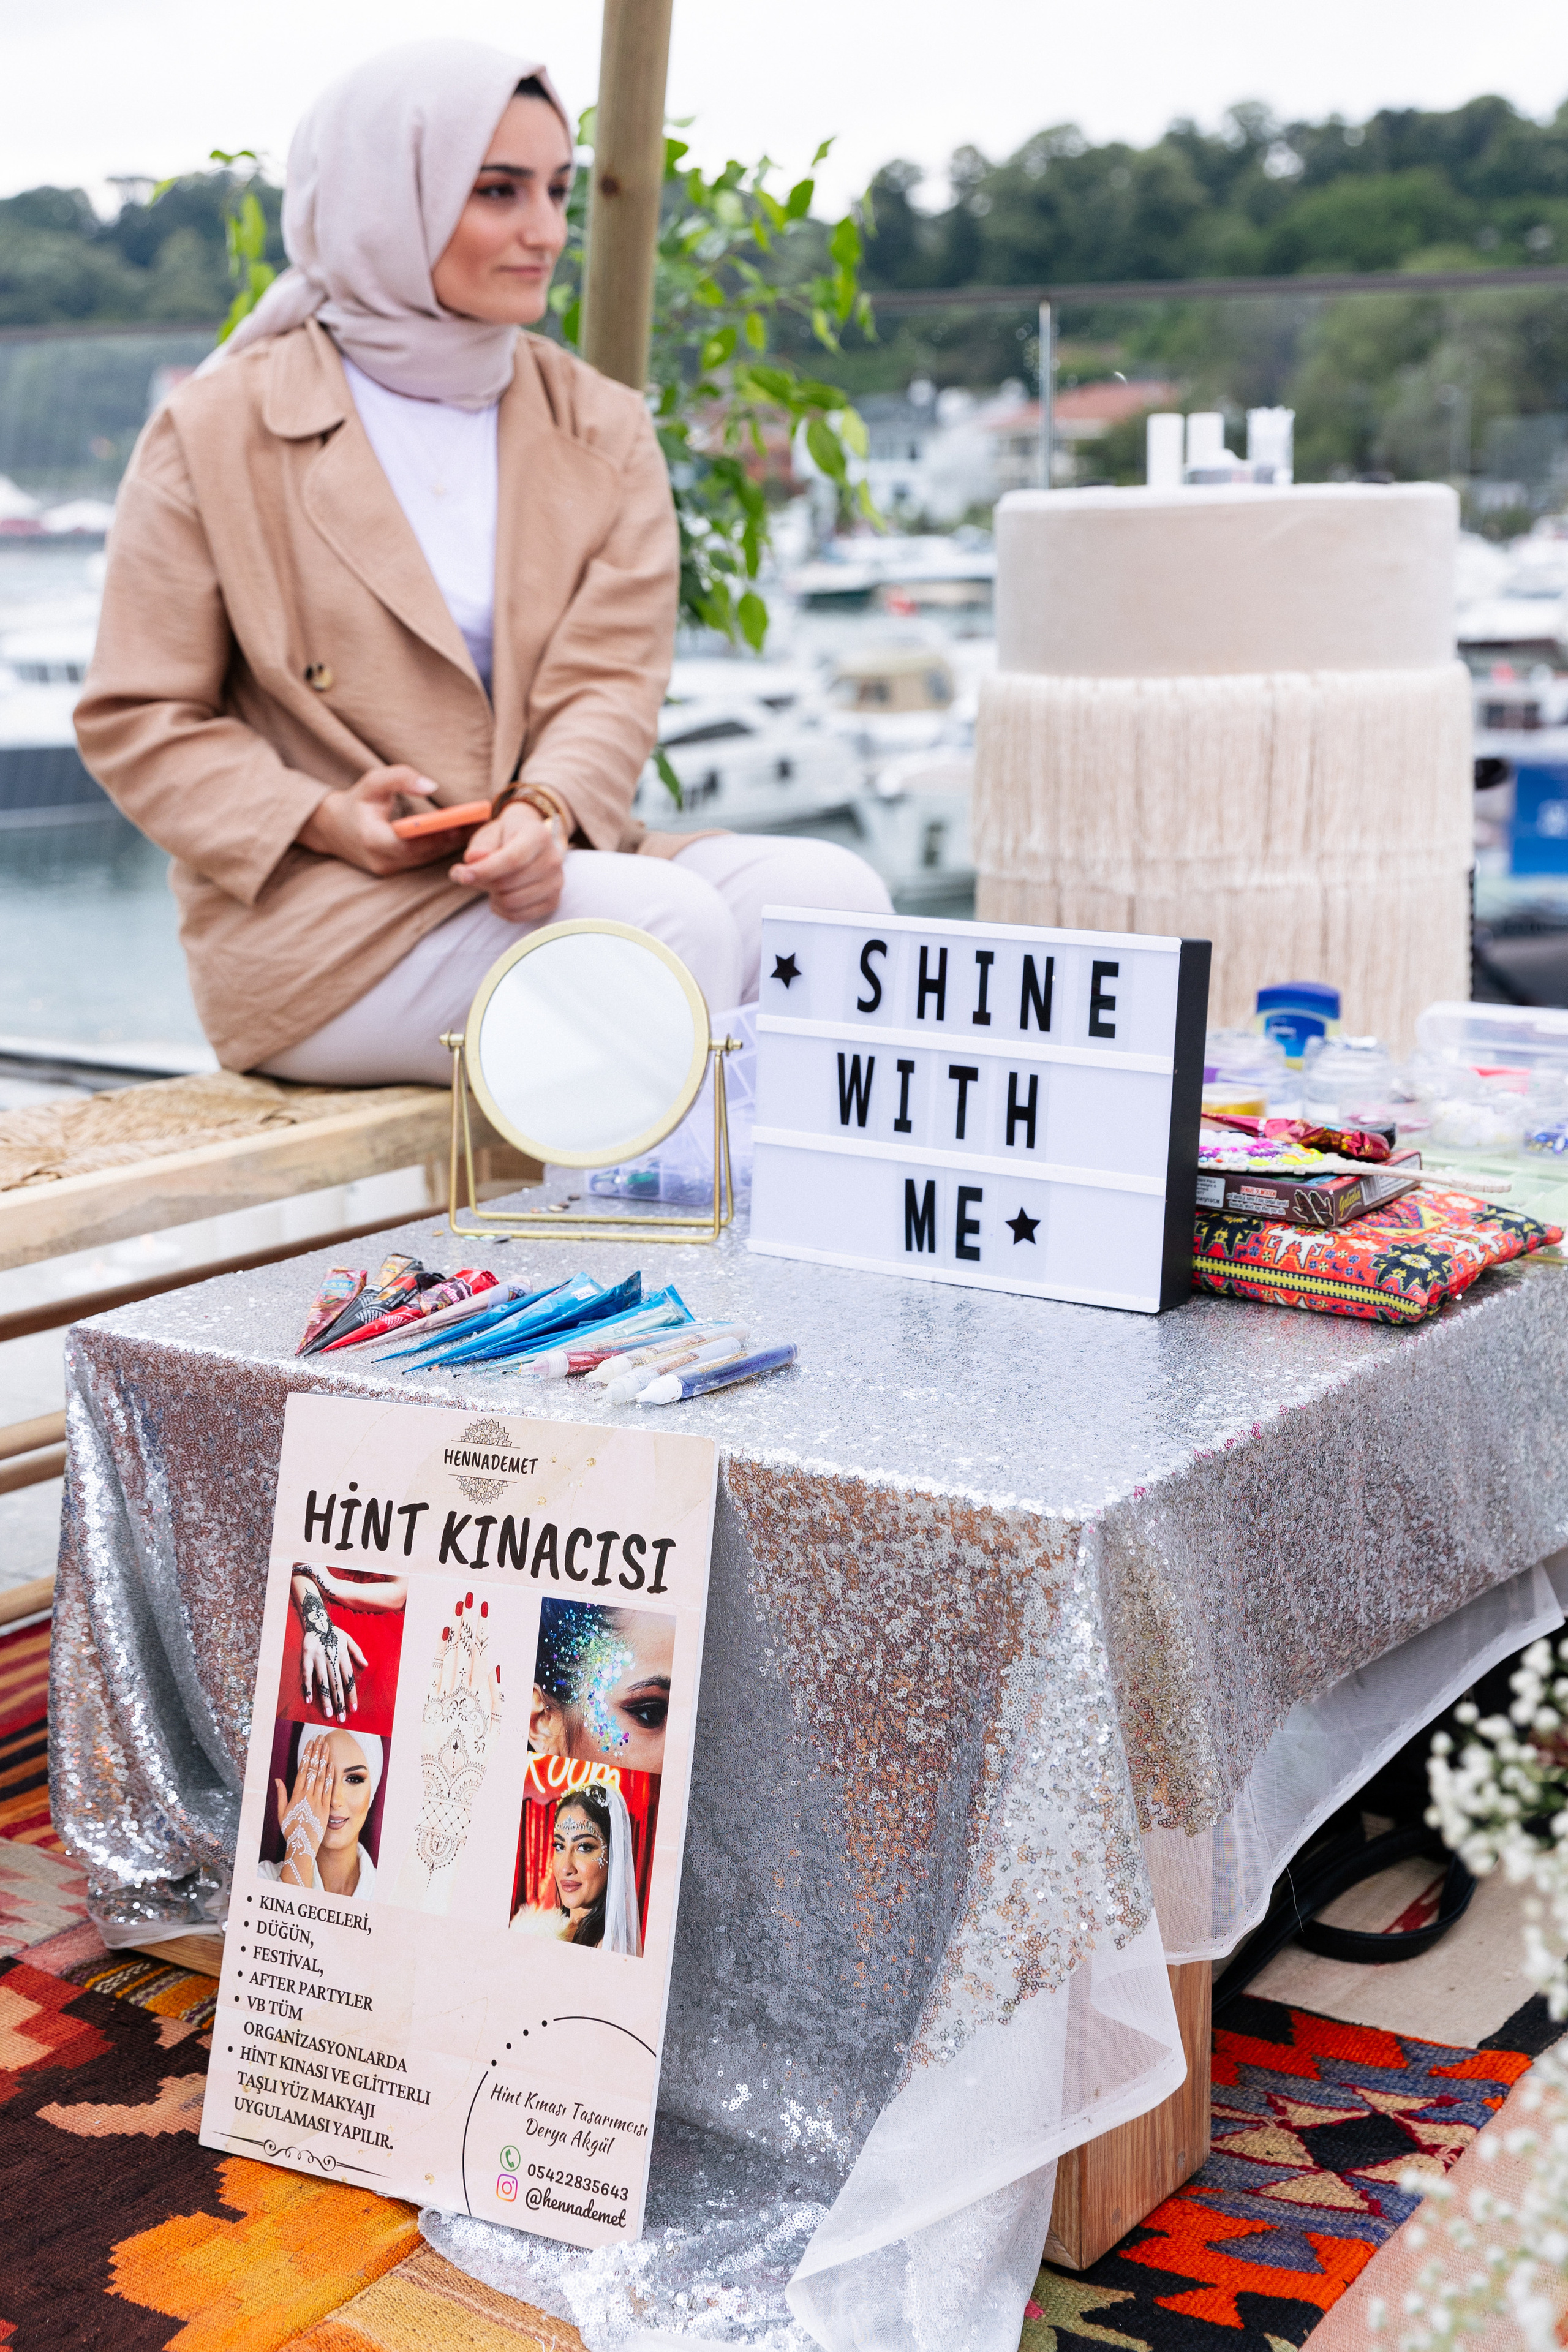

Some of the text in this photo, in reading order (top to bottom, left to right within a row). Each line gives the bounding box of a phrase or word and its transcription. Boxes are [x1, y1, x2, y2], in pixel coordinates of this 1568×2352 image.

[858, 940, 1118, 1038] SHINE
[838, 1053, 1038, 1148] WITH
[905, 1179, 982, 1261] ME
[445, 1449, 538, 1474] HENNADEMET
[305, 1482, 676, 1593] HİNT KINACISI
[257, 1920, 313, 1948] DÜĞÜN,
[260, 1896, 371, 1935] KINA GECELERİ,
[254, 1946, 323, 1977] FESTİVAL,
[247, 1996, 303, 2021] VB TÜM
[249, 1972, 372, 2011] AFTER PARTYLER
[244, 2022, 407, 2072] ORGANİZASYONLARDA
[238, 2071, 375, 2120] TAŞLI YÜZ MAKYAJI
[240, 2045, 431, 2105] HİNT KINASI VE GLİTTERLI
[235, 2097, 393, 2149] UYGULAMASI YAPILIR.
[491, 2084, 647, 2136] Hint Kınası Tasarımcısı
[526, 2118, 615, 2157] Derya Akgül
[528, 2164, 628, 2200] 05422835643
[526, 2188, 626, 2228] @hennademet
